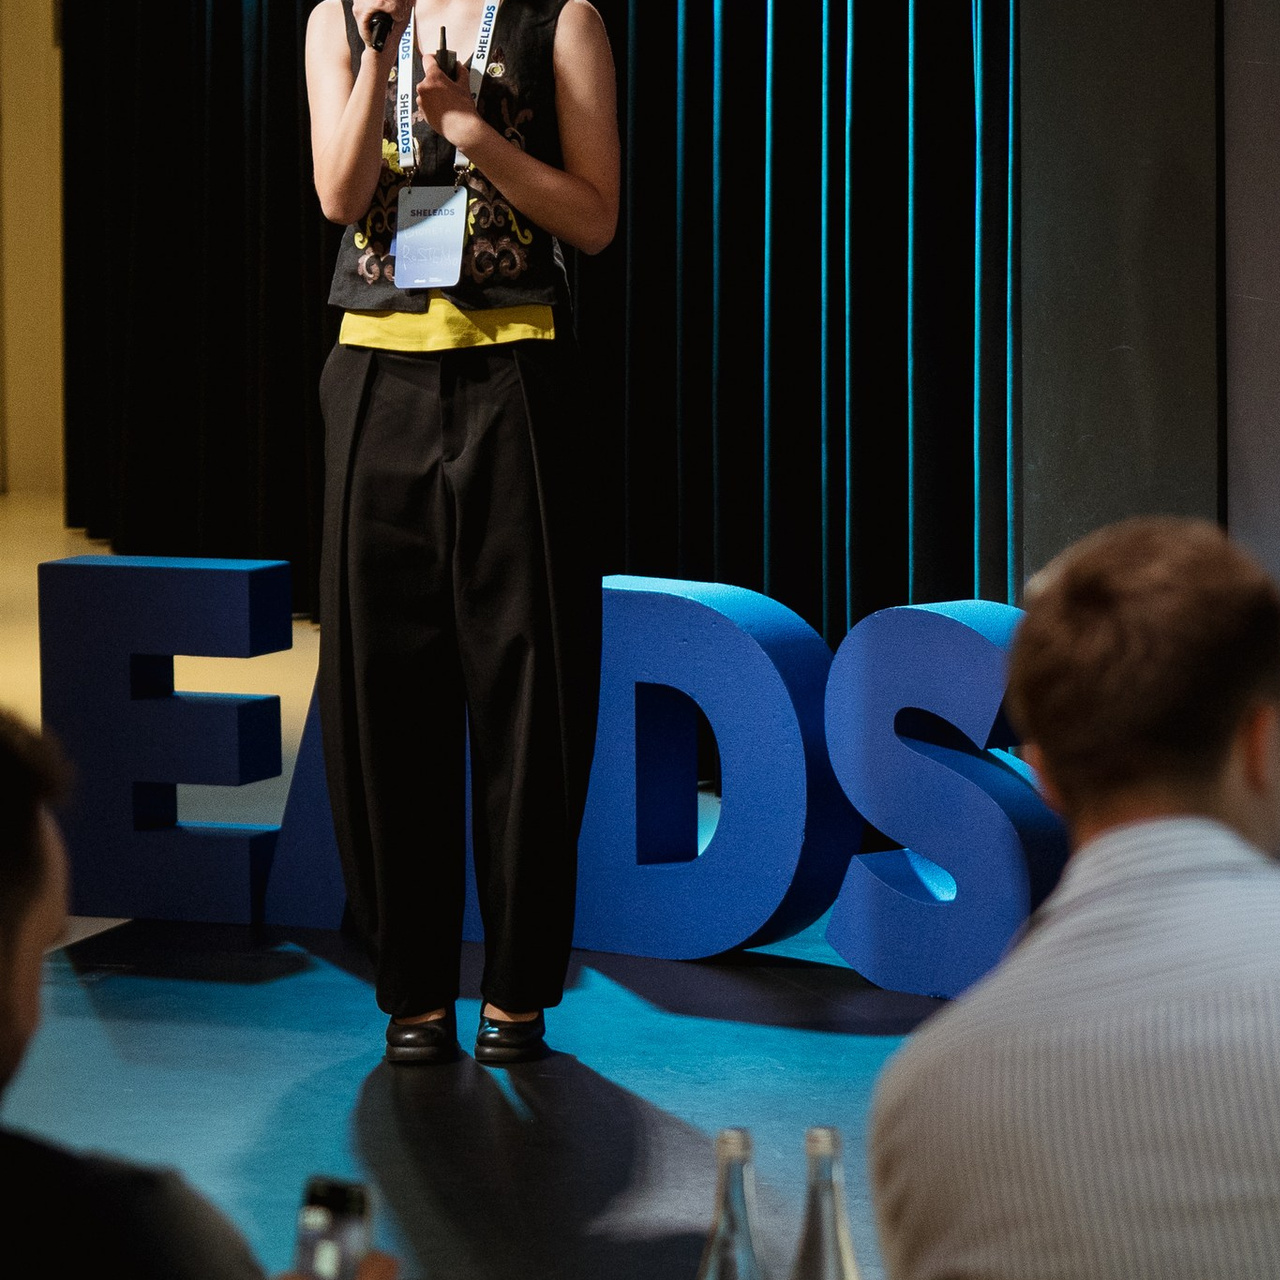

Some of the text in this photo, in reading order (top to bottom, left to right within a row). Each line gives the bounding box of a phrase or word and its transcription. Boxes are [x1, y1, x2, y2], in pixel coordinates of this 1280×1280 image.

[476, 4, 496, 60] SHELEADS
[400, 93, 411, 154] SHELEADS
[410, 208, 455, 217] SHELEADS
[38, 558, 1040, 997] EDS
